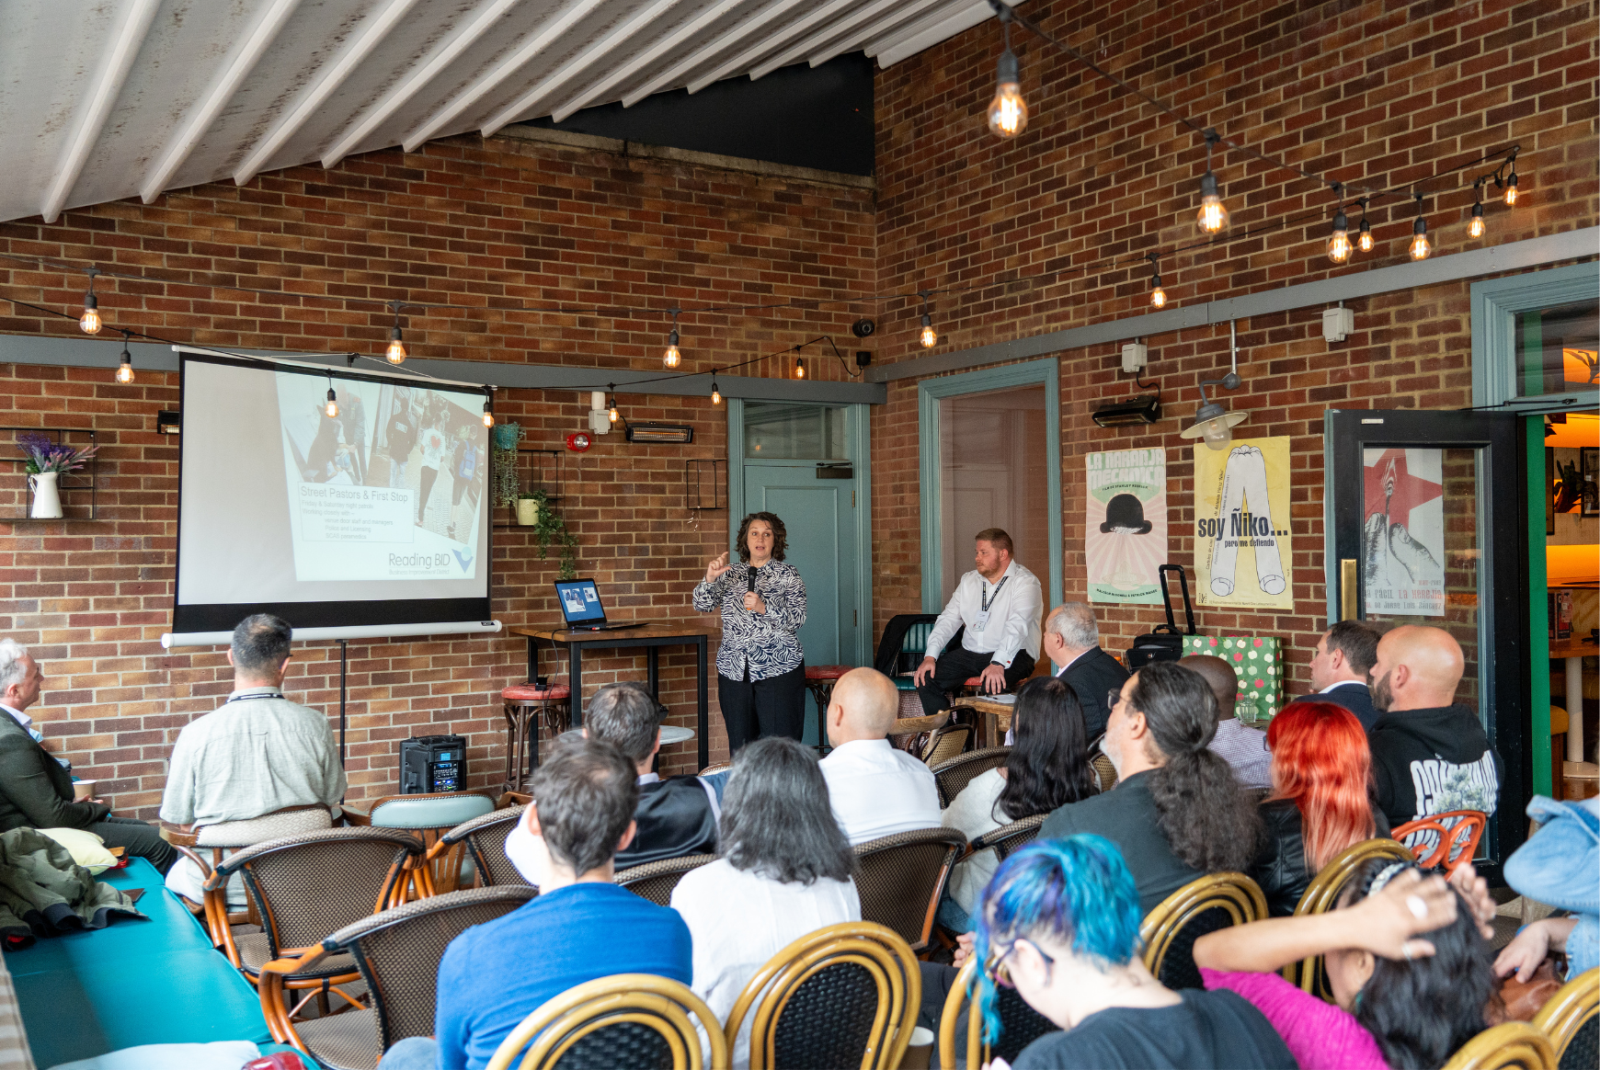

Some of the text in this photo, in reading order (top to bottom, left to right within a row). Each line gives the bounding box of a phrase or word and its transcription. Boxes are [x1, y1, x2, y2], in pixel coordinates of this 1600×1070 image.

[1087, 448, 1164, 470] LA NARANJA
[300, 486, 408, 504] Street Pastors & First Stop
[1198, 508, 1288, 540] soy Ñiko...
[1225, 540, 1238, 548] pero
[1250, 539, 1274, 547] defiendo
[389, 552, 450, 569] Reading BID
